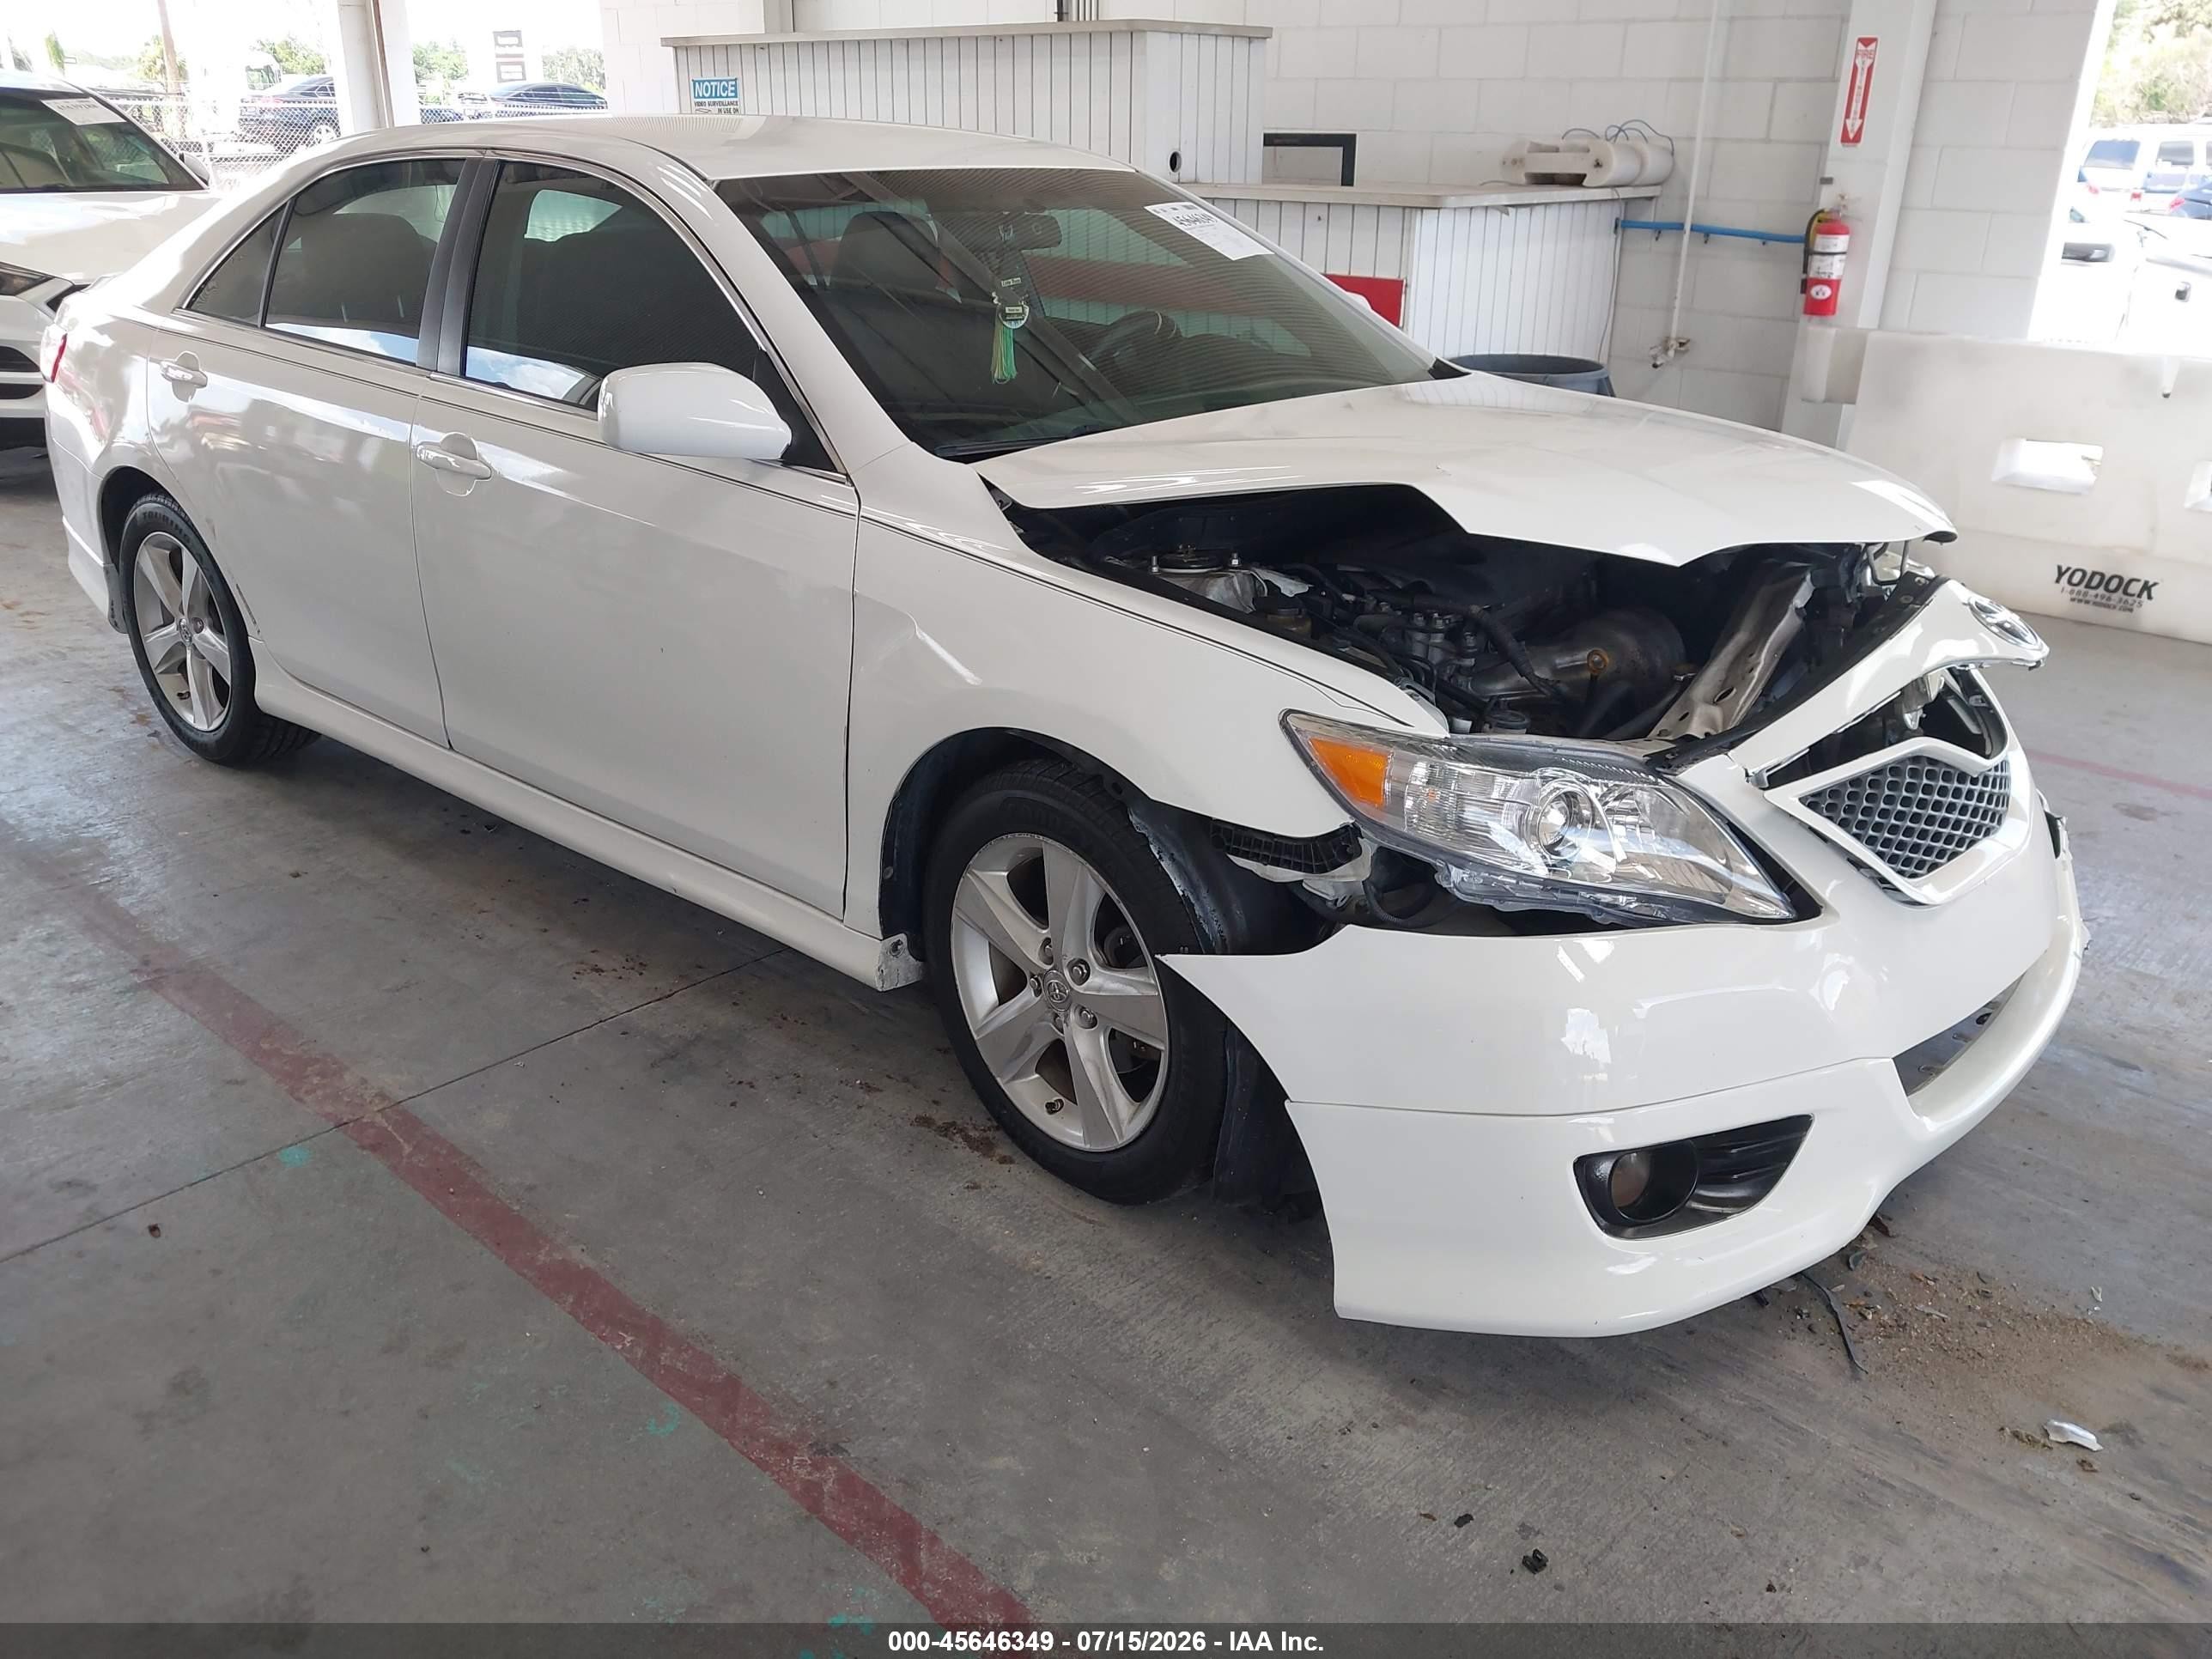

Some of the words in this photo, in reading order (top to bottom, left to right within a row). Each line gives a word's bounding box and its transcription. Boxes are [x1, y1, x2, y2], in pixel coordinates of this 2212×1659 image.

[1856, 49, 1874, 59] FIRE
[695, 81, 736, 97] NOTICE
[2055, 564, 2160, 600] YODOCK
